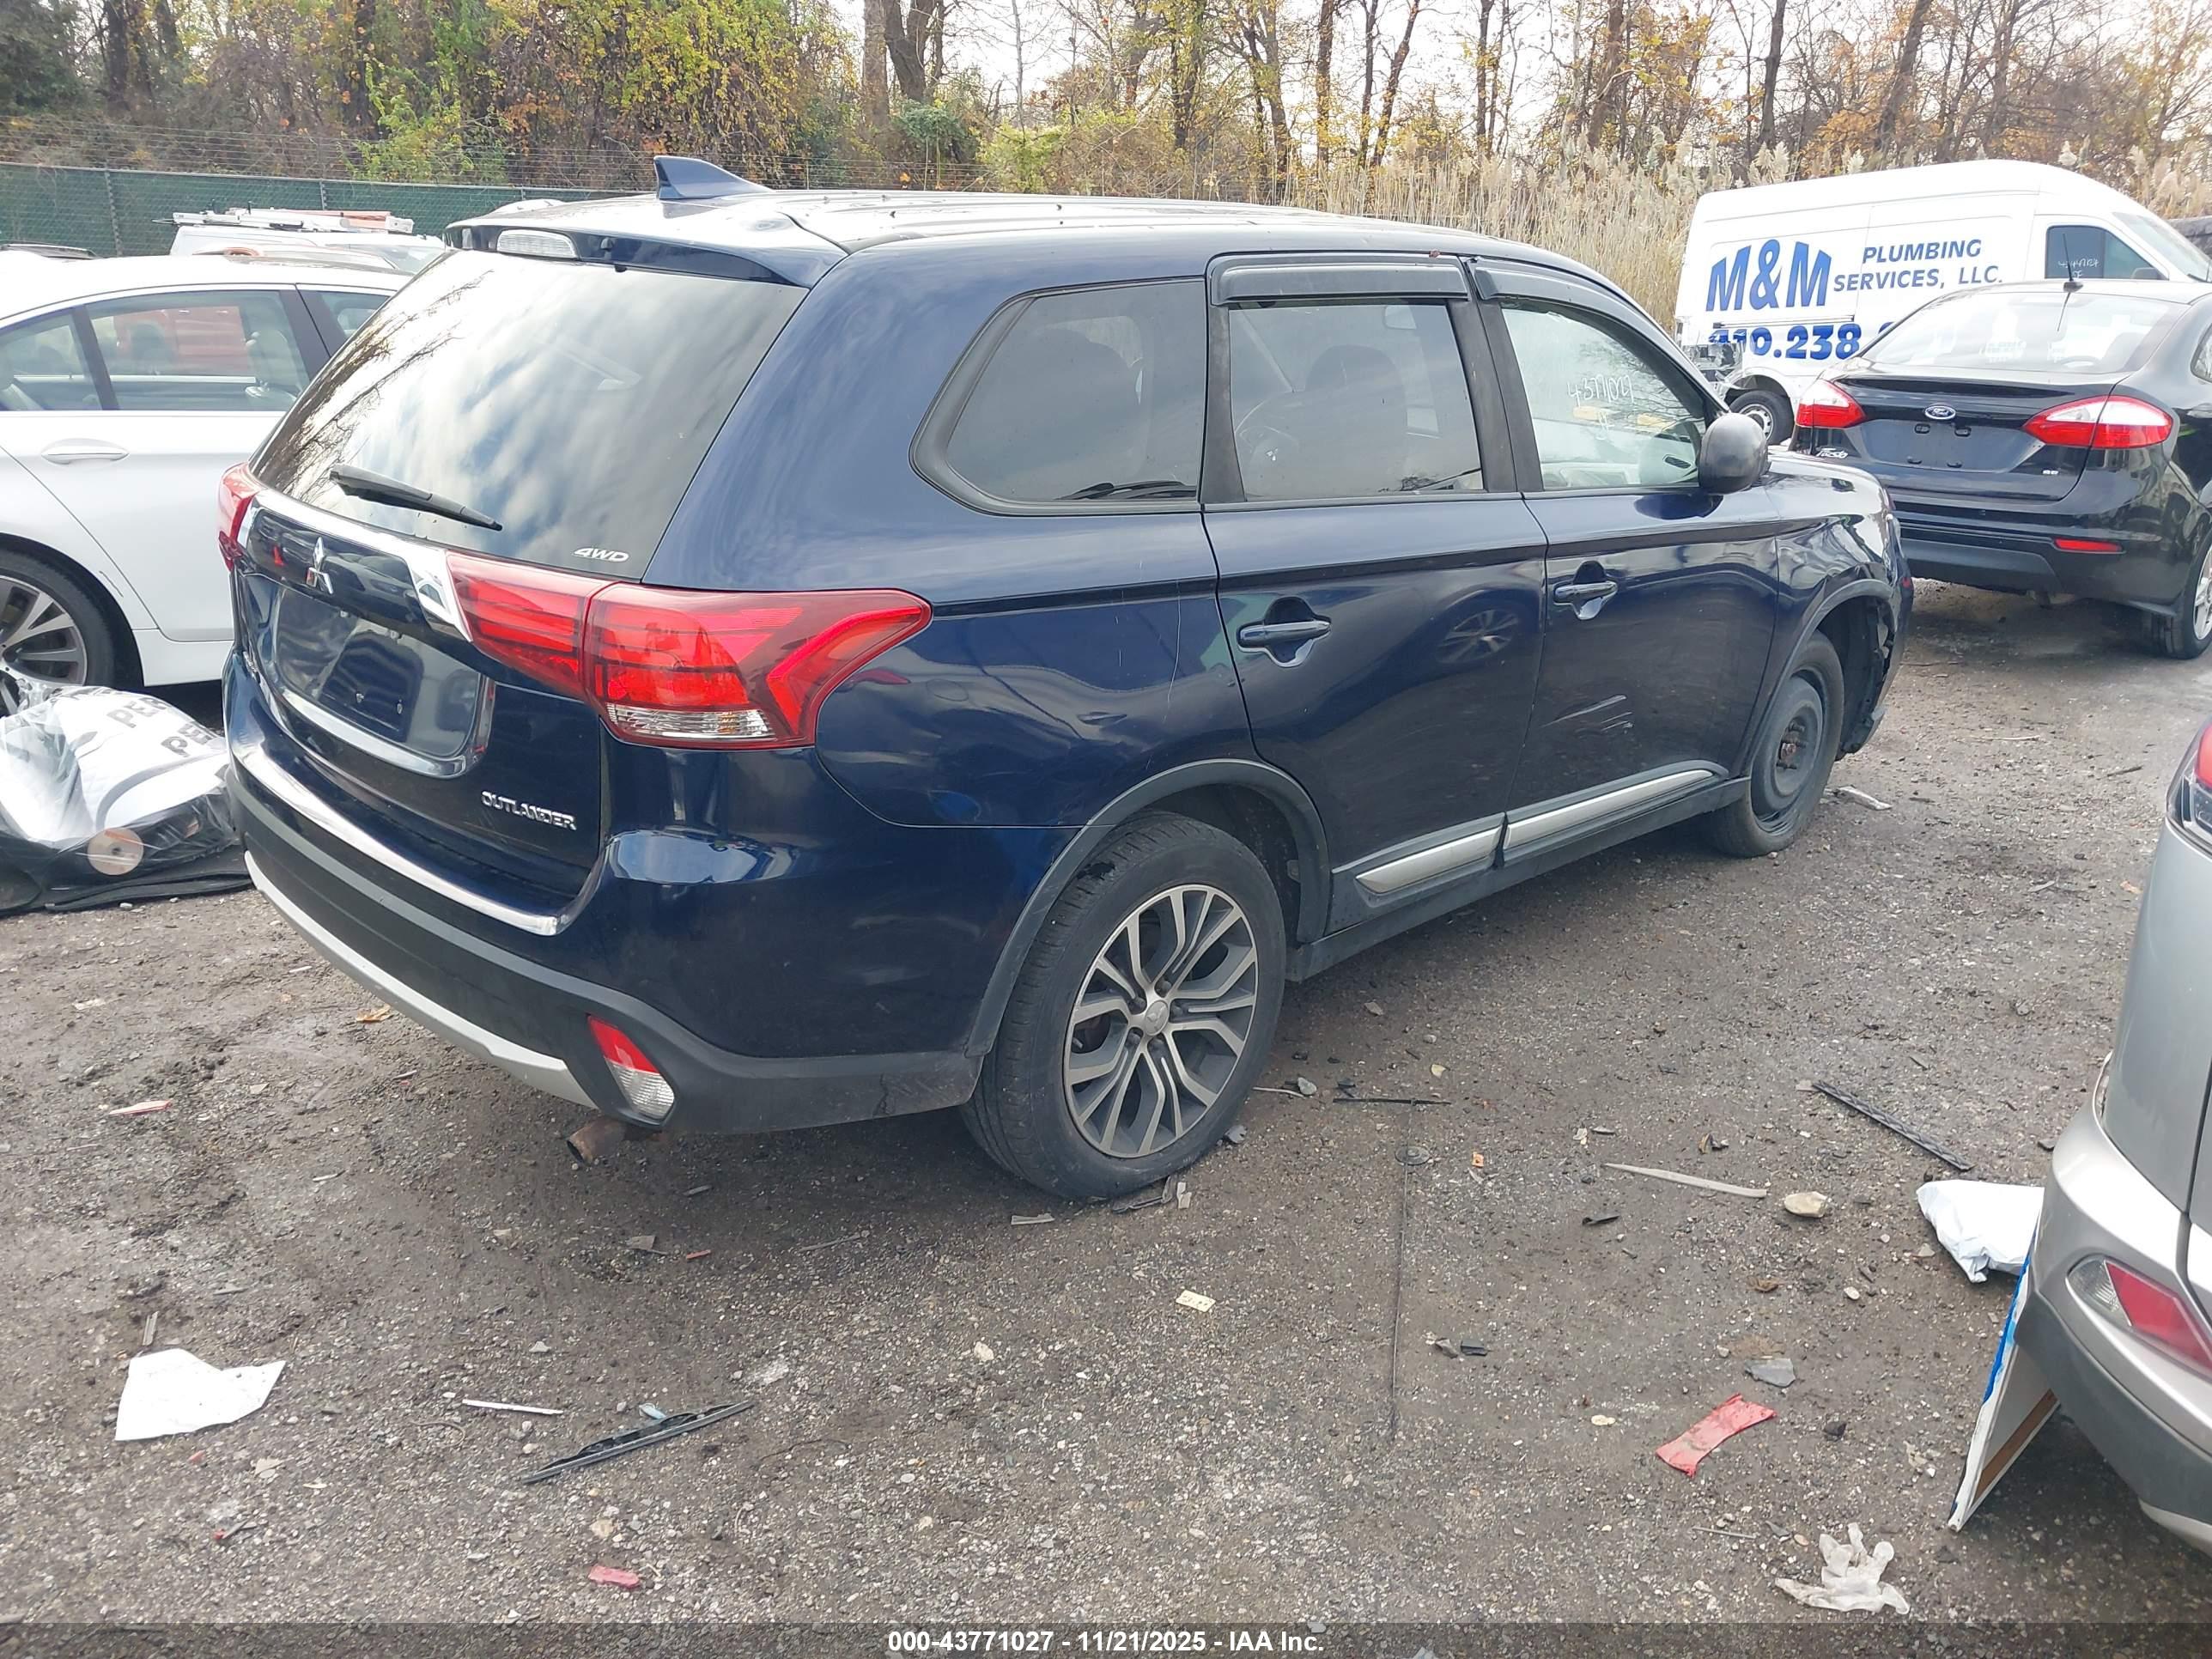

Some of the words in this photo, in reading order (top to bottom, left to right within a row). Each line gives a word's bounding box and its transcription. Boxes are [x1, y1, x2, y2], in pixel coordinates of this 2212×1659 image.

[1863, 239, 1982, 264] PLUMBING
[1705, 239, 1832, 312] M&M
[1833, 268, 1945, 292] SERVICES,
[1959, 264, 2003, 284] LLC.
[574, 547, 629, 562] 4WD
[481, 790, 577, 831] OUTLANDER
